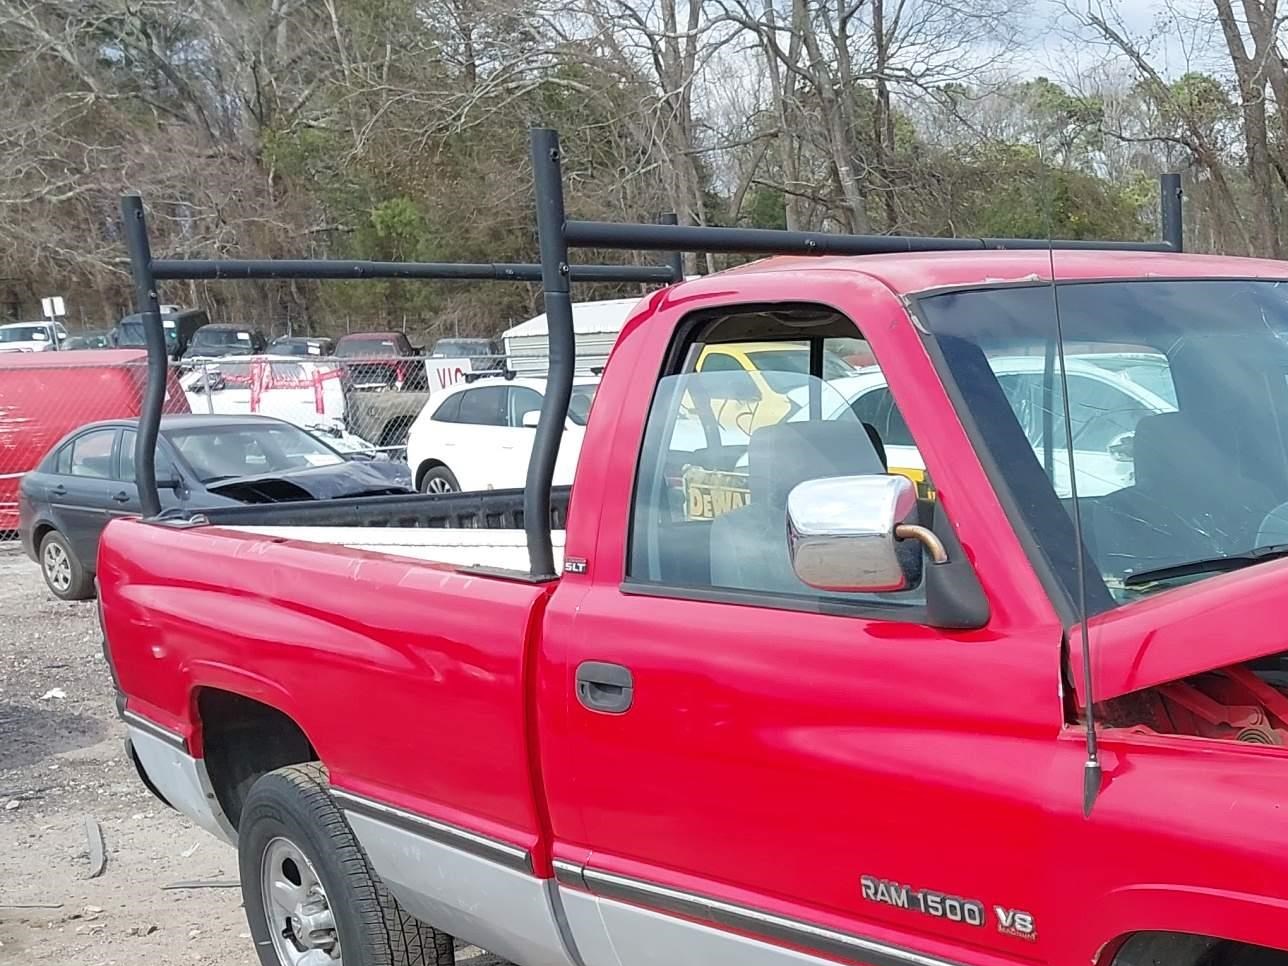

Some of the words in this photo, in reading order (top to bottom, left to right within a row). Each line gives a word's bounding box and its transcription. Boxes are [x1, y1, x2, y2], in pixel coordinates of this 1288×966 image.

[565, 562, 587, 573] SLT
[860, 877, 909, 909] RAM
[917, 891, 982, 927] 1500
[994, 906, 1035, 934] V8
